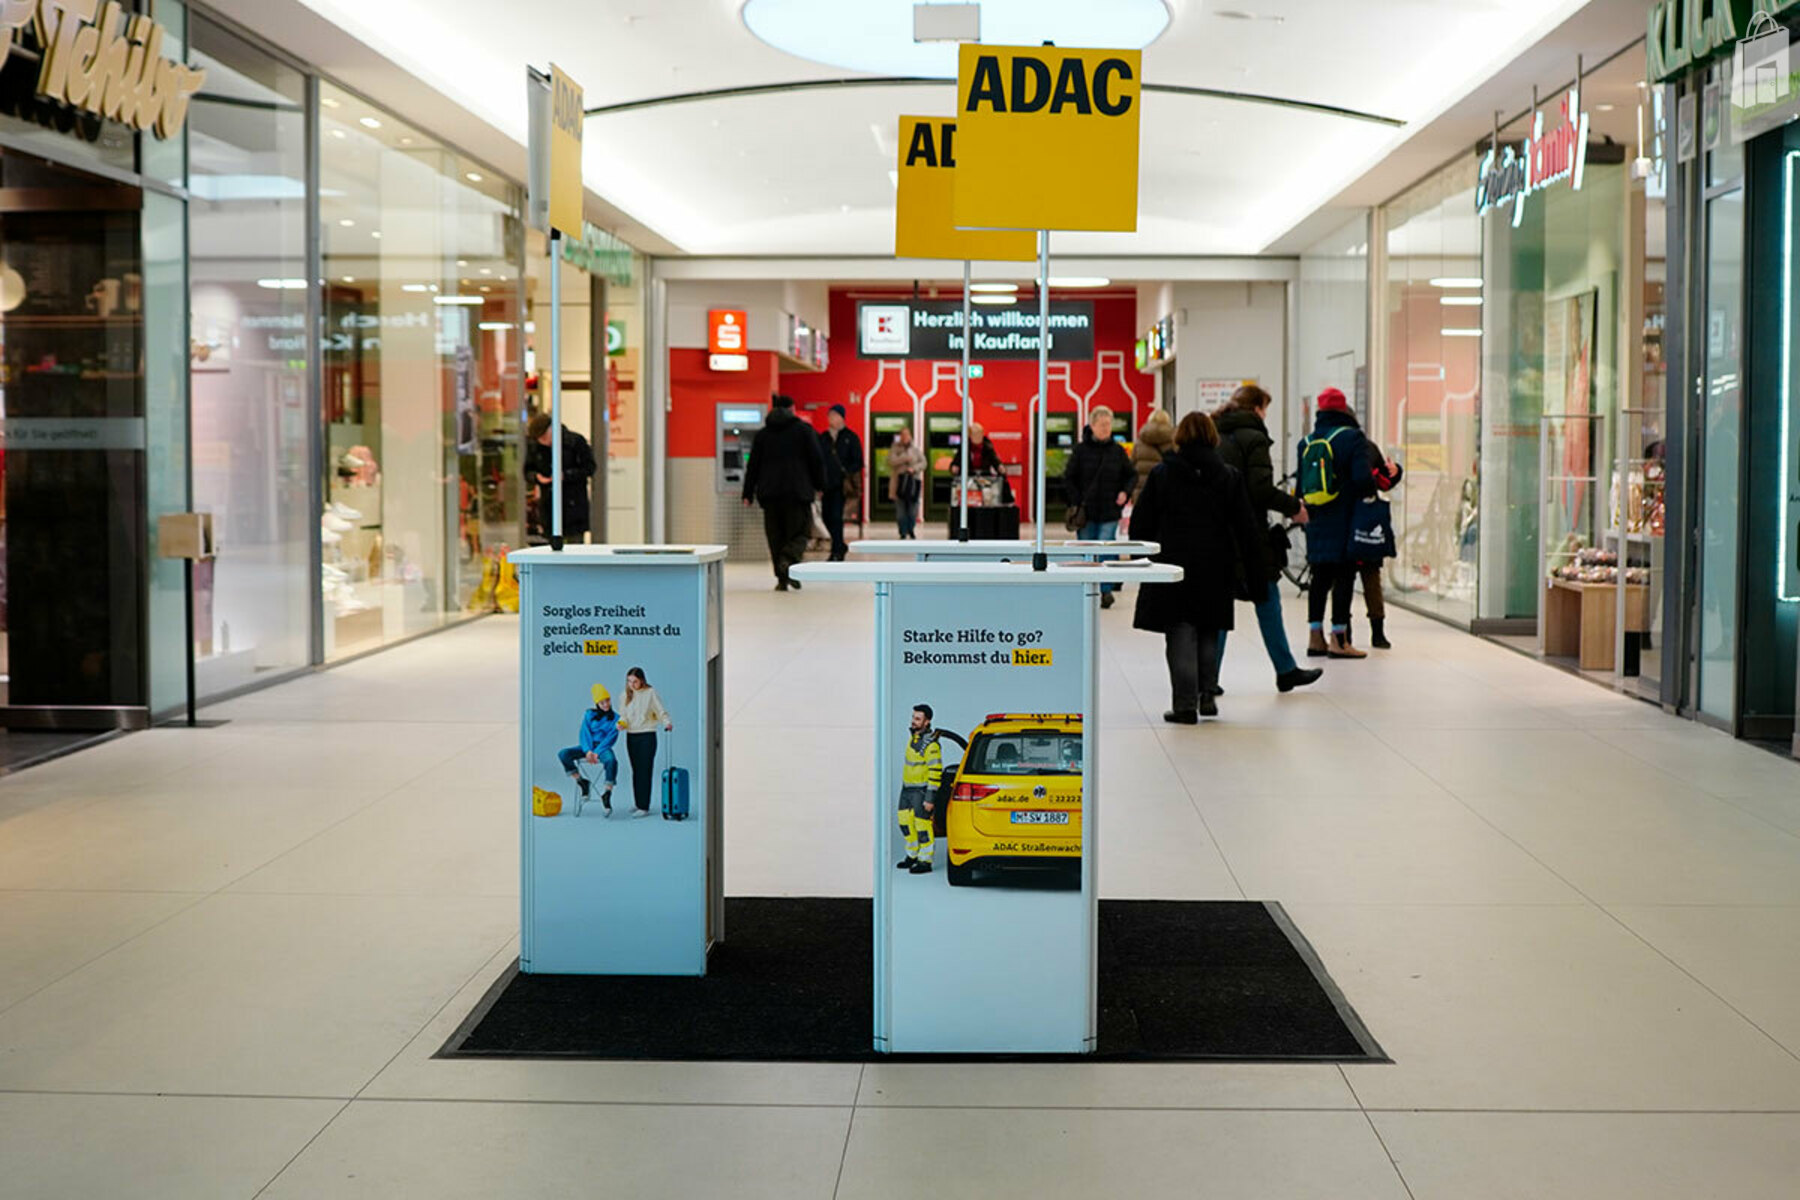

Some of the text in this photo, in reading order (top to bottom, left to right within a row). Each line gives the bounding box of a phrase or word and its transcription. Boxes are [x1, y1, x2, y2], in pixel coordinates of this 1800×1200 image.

[965, 55, 1133, 117] ADAC
[905, 122, 957, 168] AD
[913, 310, 984, 328] Herzlih
[542, 605, 646, 619] Sorglos Freiheit
[542, 623, 681, 638] genießen? Kannst du
[903, 629, 1043, 646] Starke Hilfe to go?
[542, 642, 616, 656] gleich hier.
[903, 651, 1050, 664] Bekommst du hier.
[997, 795, 1029, 803] adac.de
[1044, 813, 1068, 823] 1887
[993, 843, 1018, 852] ADAC
